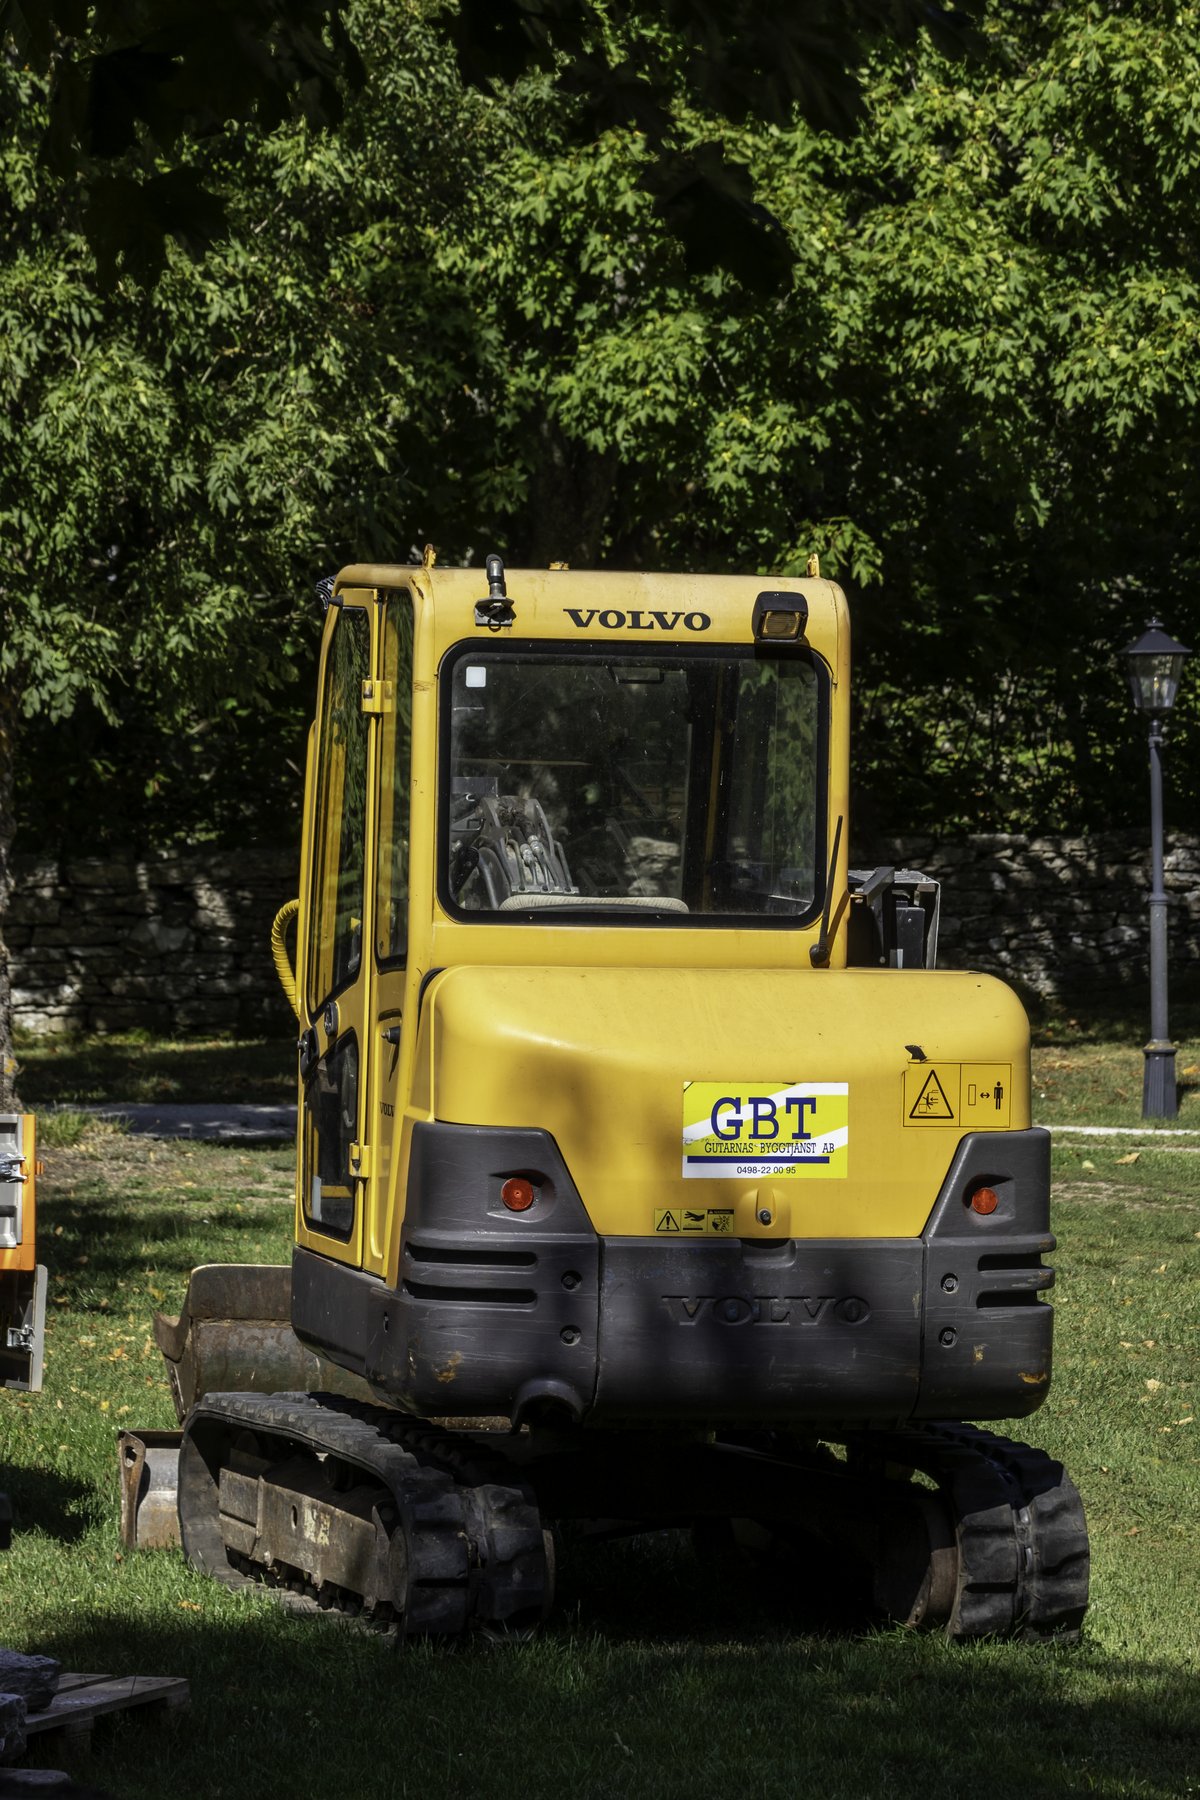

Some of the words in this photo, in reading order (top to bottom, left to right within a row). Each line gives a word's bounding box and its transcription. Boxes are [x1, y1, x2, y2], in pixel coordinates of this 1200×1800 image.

[563, 608, 711, 631] VOLVO
[379, 1100, 395, 1117] VOLV
[710, 1096, 817, 1141] GBT
[704, 1142, 754, 1154] GUTARNAS
[760, 1141, 817, 1156] BYGGTJÄNST
[822, 1142, 835, 1154] AB
[736, 1166, 772, 1174] 0498-22
[773, 1166, 784, 1174] 00
[785, 1166, 797, 1174] 95
[661, 1295, 871, 1326] VOLVO
